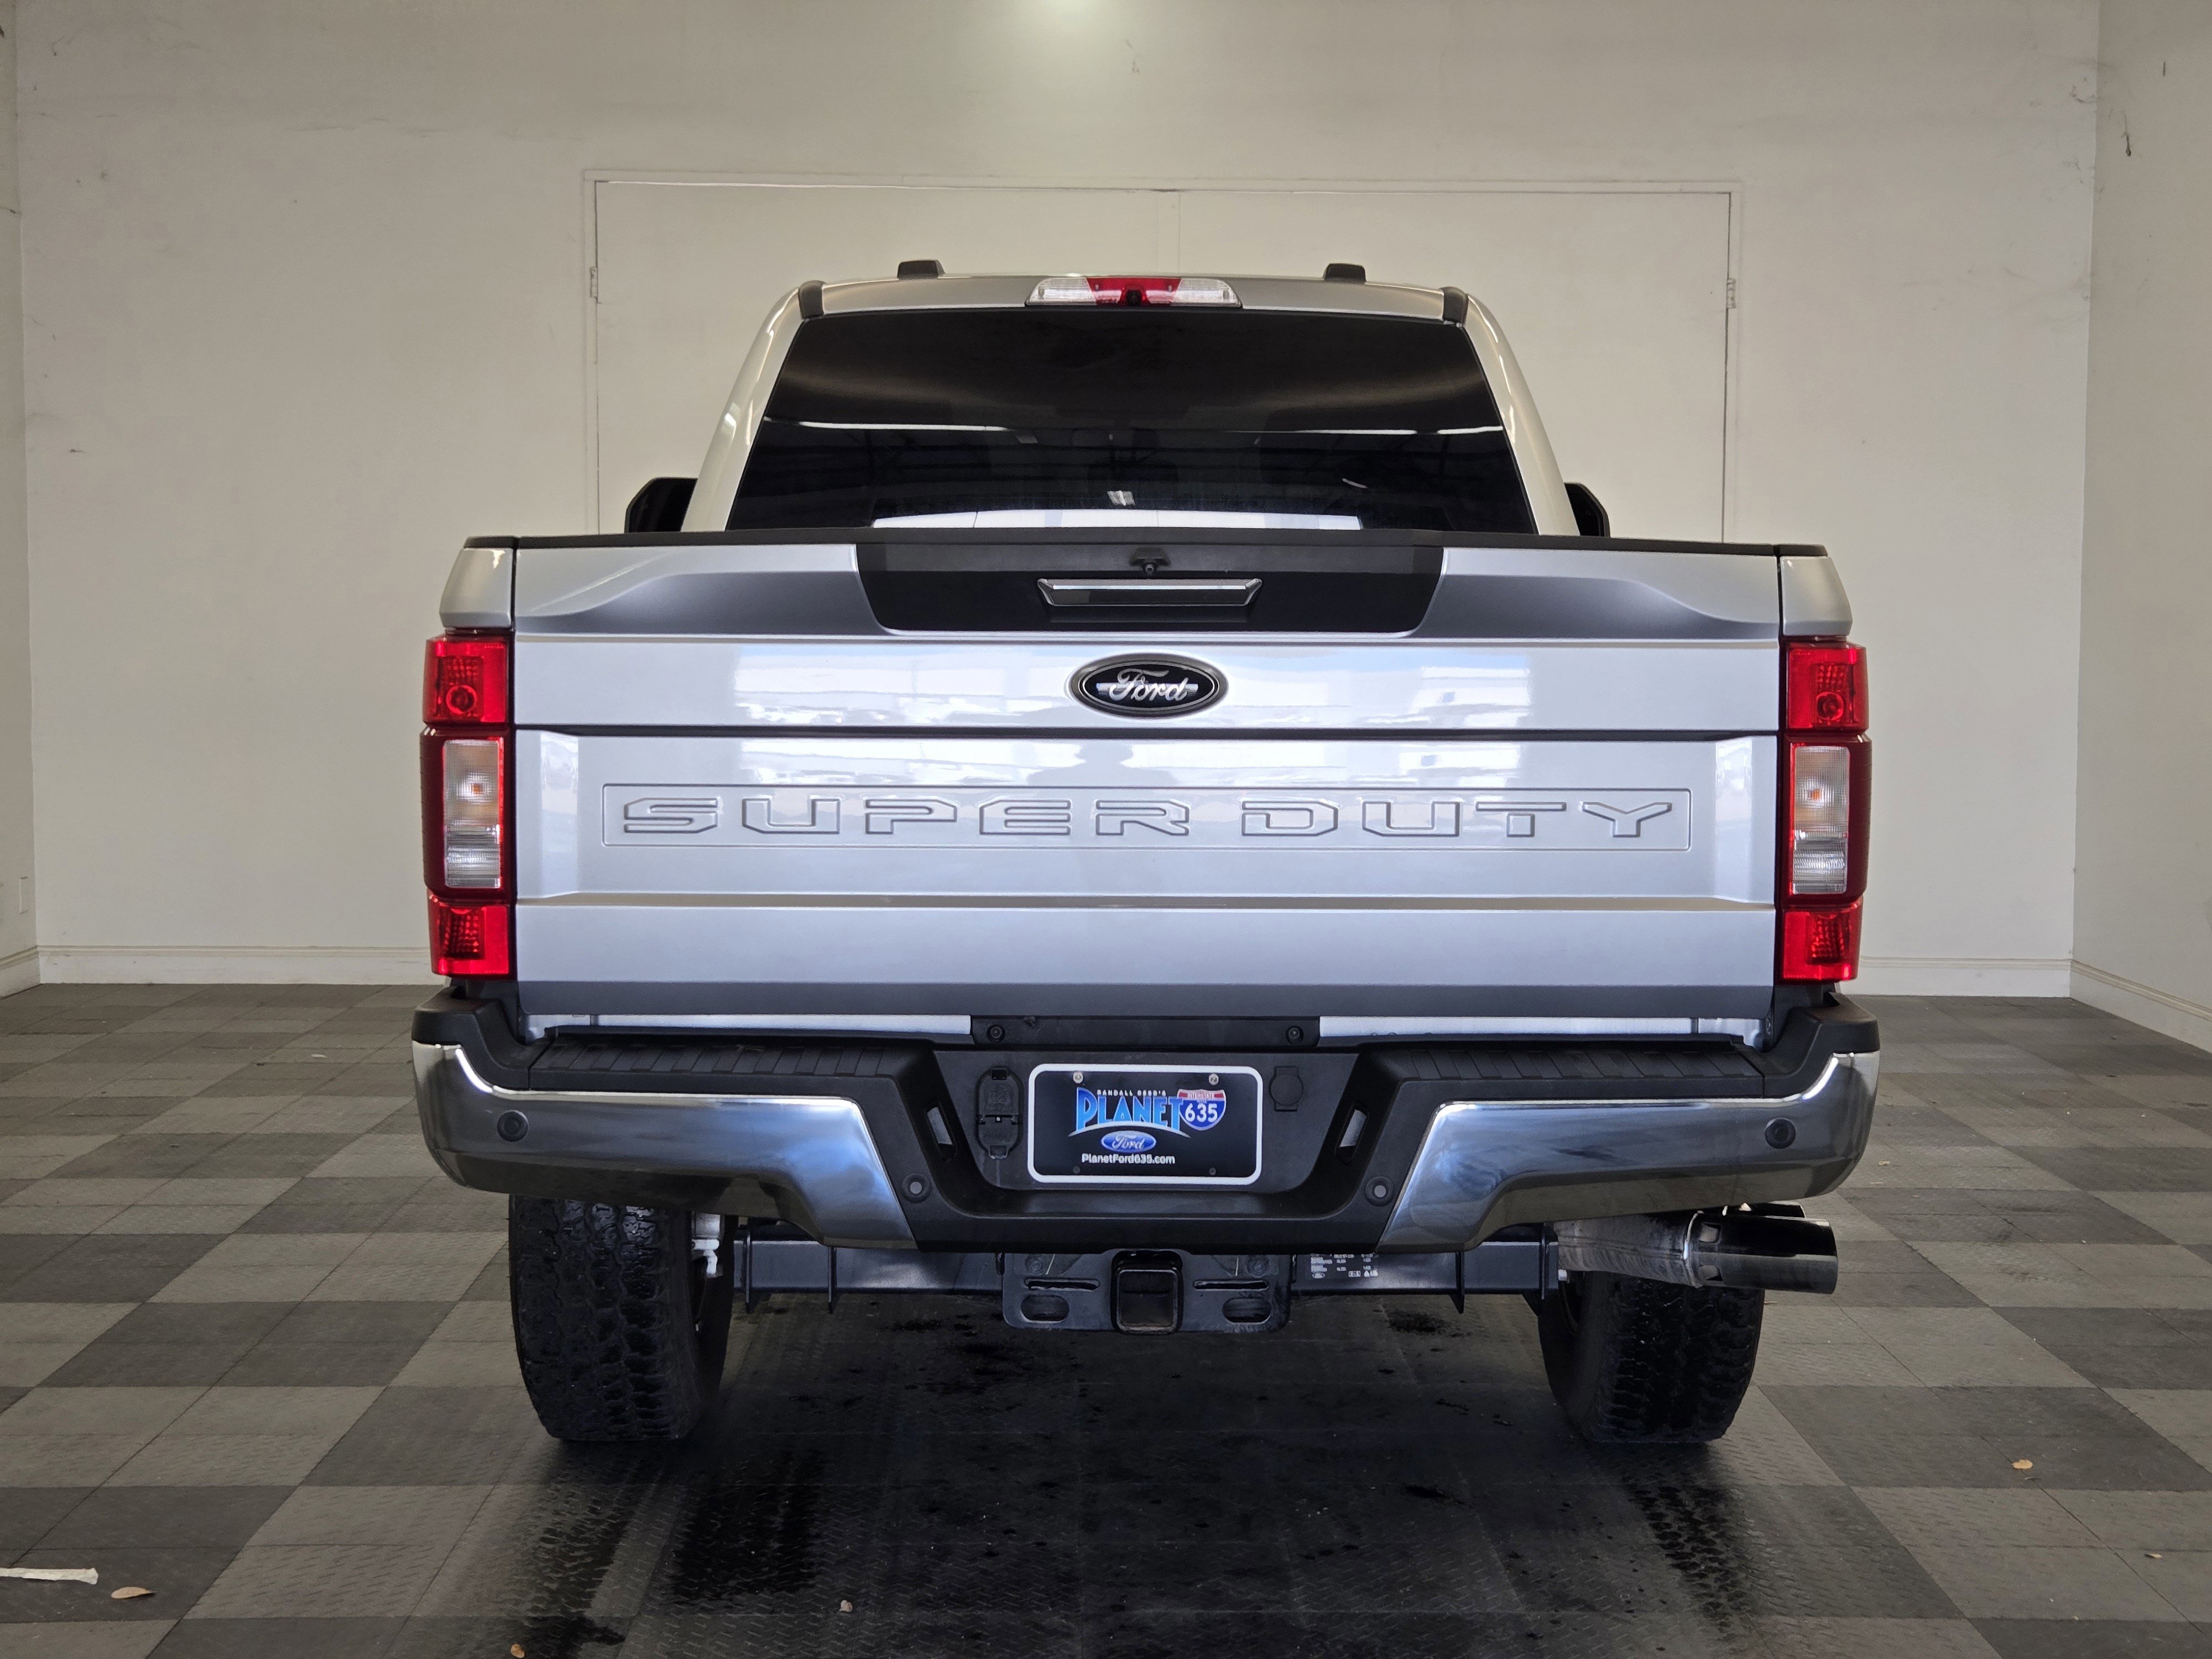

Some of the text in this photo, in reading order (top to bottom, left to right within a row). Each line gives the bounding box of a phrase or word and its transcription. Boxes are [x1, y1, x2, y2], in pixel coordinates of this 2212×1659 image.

[1109, 668, 1189, 701] Ford
[624, 797, 1673, 838] SUPER DUTY
[1076, 1087, 1183, 1131] PLANET
[1185, 1103, 1218, 1123] 635
[1112, 1134, 1146, 1150] Ford
